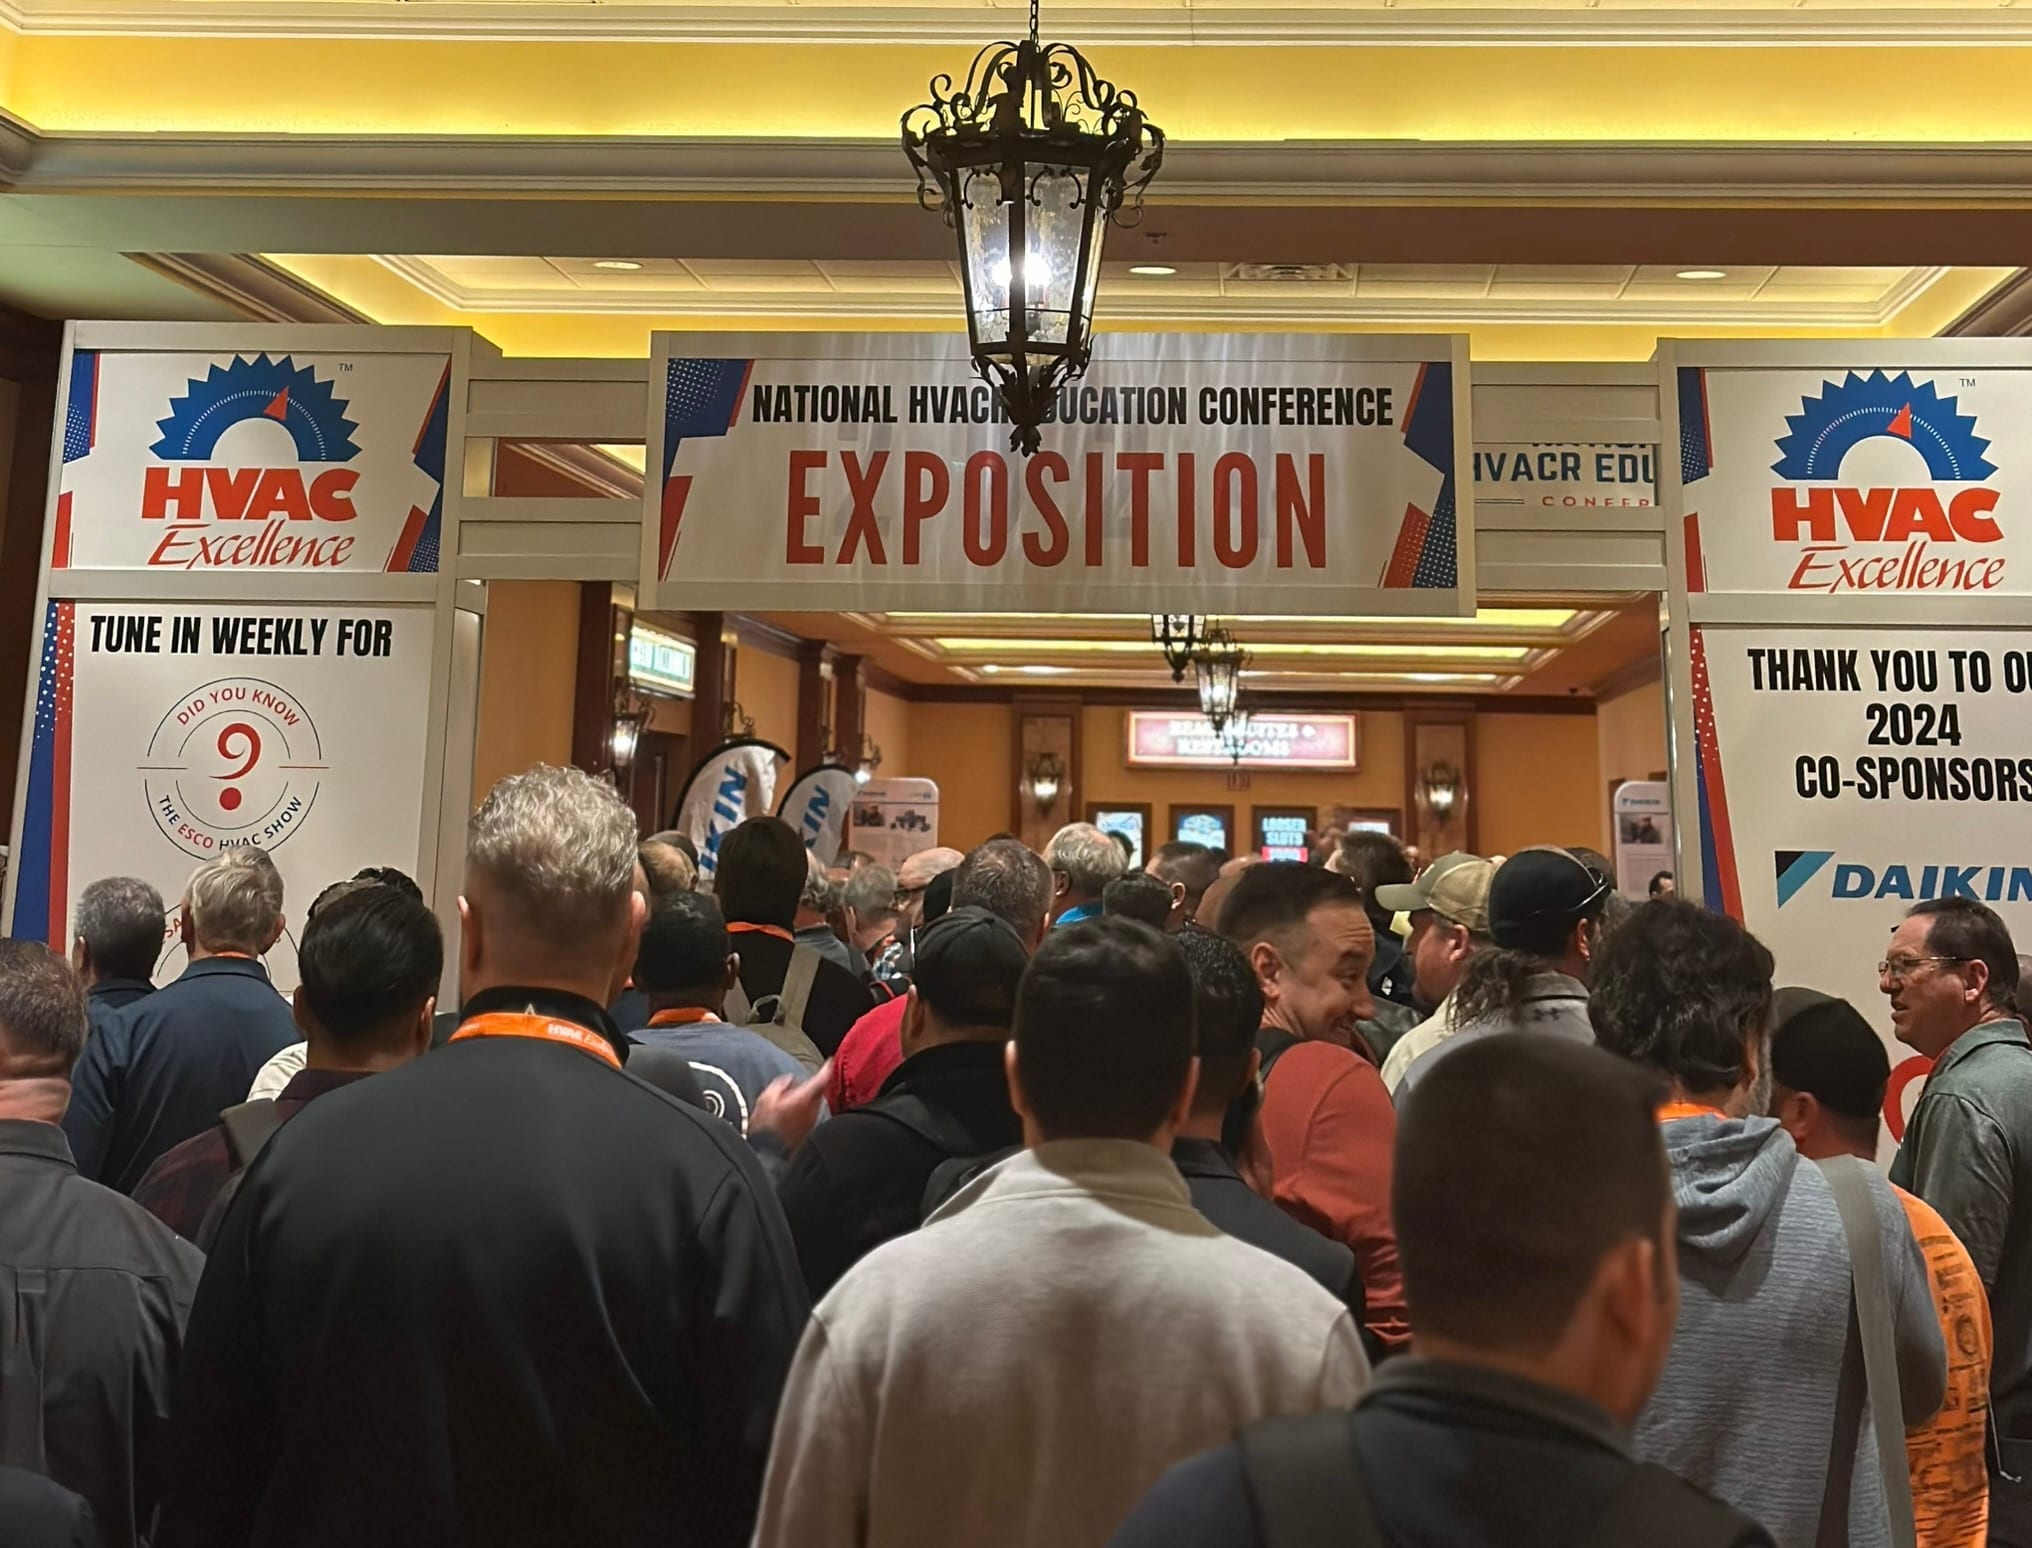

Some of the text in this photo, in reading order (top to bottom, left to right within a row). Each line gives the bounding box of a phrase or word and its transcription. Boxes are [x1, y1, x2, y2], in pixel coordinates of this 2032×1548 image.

[752, 385, 897, 424] NATIONAL
[1040, 386, 1187, 425] UCATION
[1198, 387, 1394, 427] CONFERENCE
[141, 467, 361, 521] HVAC
[786, 449, 1327, 569] EXPOSITION
[1771, 487, 2004, 543] HVAC
[147, 519, 356, 570] Excellence
[1787, 540, 2006, 594] Excellence
[90, 615, 393, 657] TUNE IN WEEKLY FOR
[1747, 648, 1862, 692] THANK
[1870, 650, 1938, 692] YOU
[1948, 650, 1992, 693] TO
[176, 687, 301, 727] DID YOU KNOW
[1866, 703, 1962, 746] 2024
[158, 794, 181, 825] THE
[177, 823, 214, 849] ESCO
[263, 796, 303, 839] SHOW
